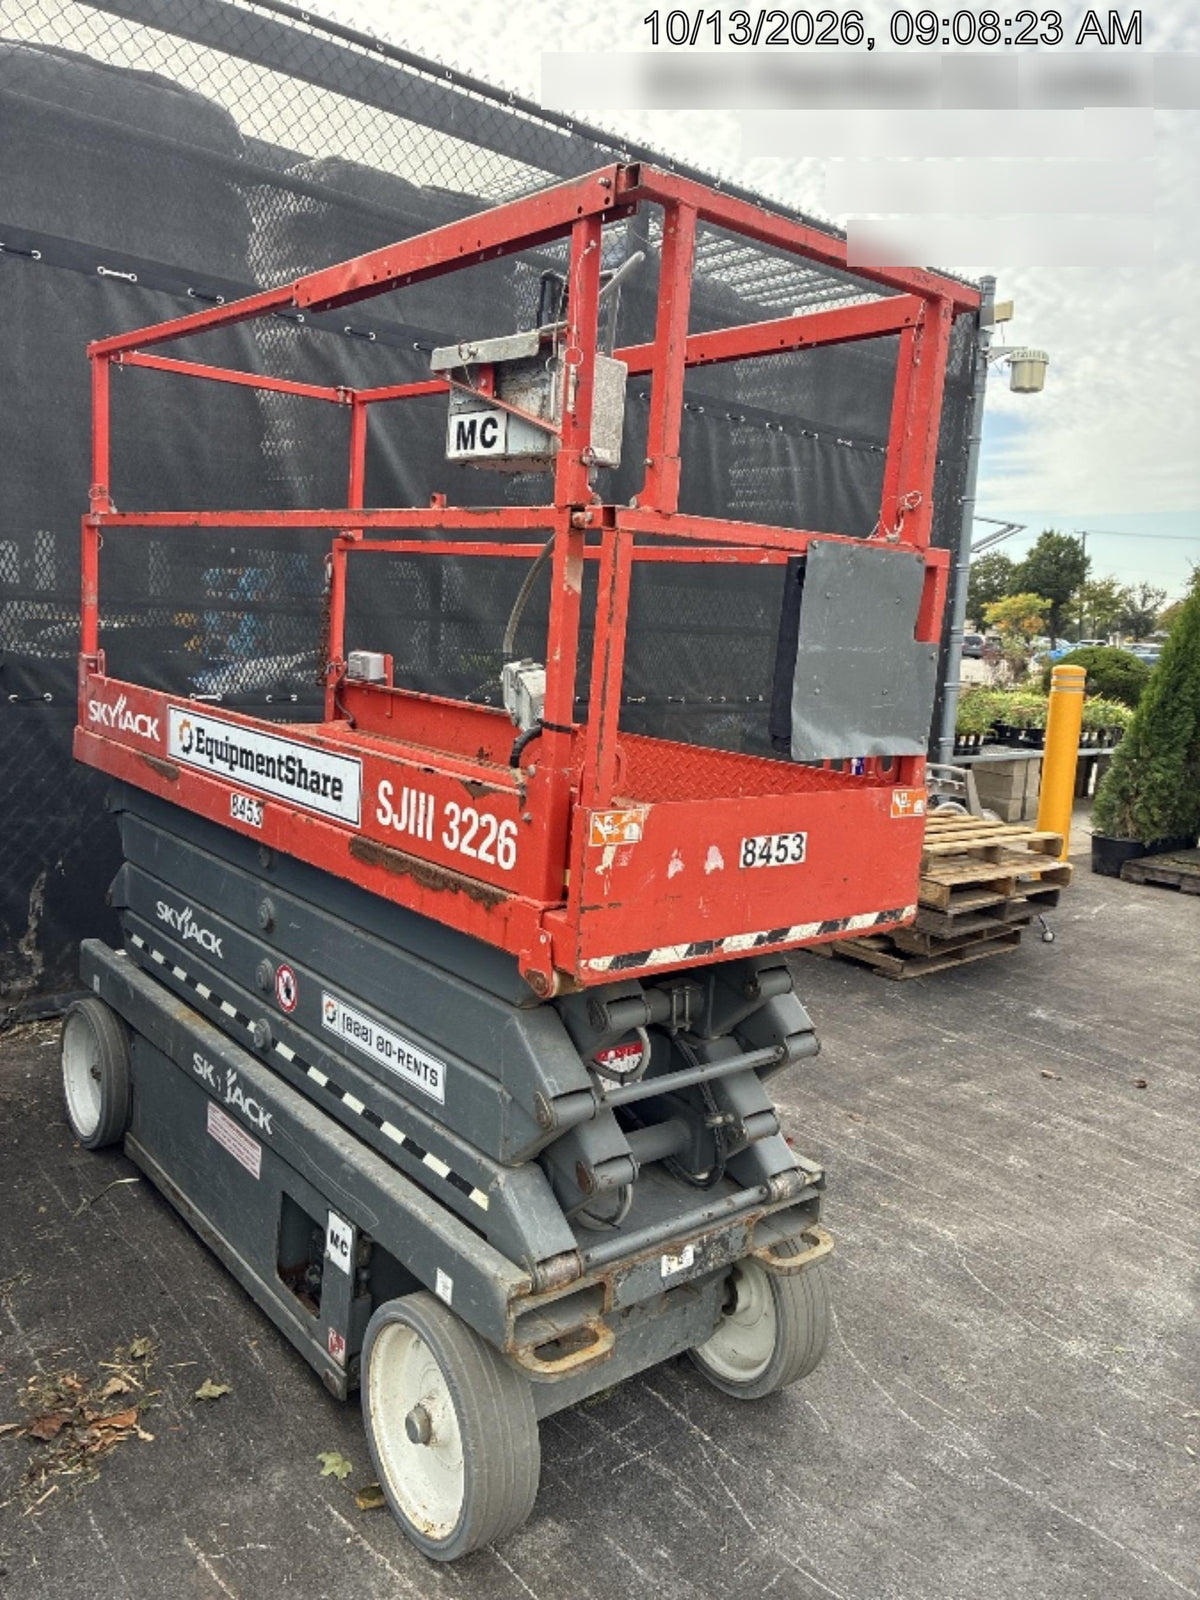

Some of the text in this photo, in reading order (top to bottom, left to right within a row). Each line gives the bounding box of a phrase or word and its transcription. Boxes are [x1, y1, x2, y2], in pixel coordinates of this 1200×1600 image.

[456, 416, 498, 451] MC
[87, 693, 161, 742] SKYJACK
[193, 725, 343, 802] EquipmentShare
[232, 793, 263, 826] 8453
[376, 780, 518, 871] SJIII 3226
[741, 832, 805, 867] 8453
[156, 900, 224, 959] SKYJACK
[376, 1035, 438, 1087] 80-RENTS
[330, 1228, 348, 1258] MC
